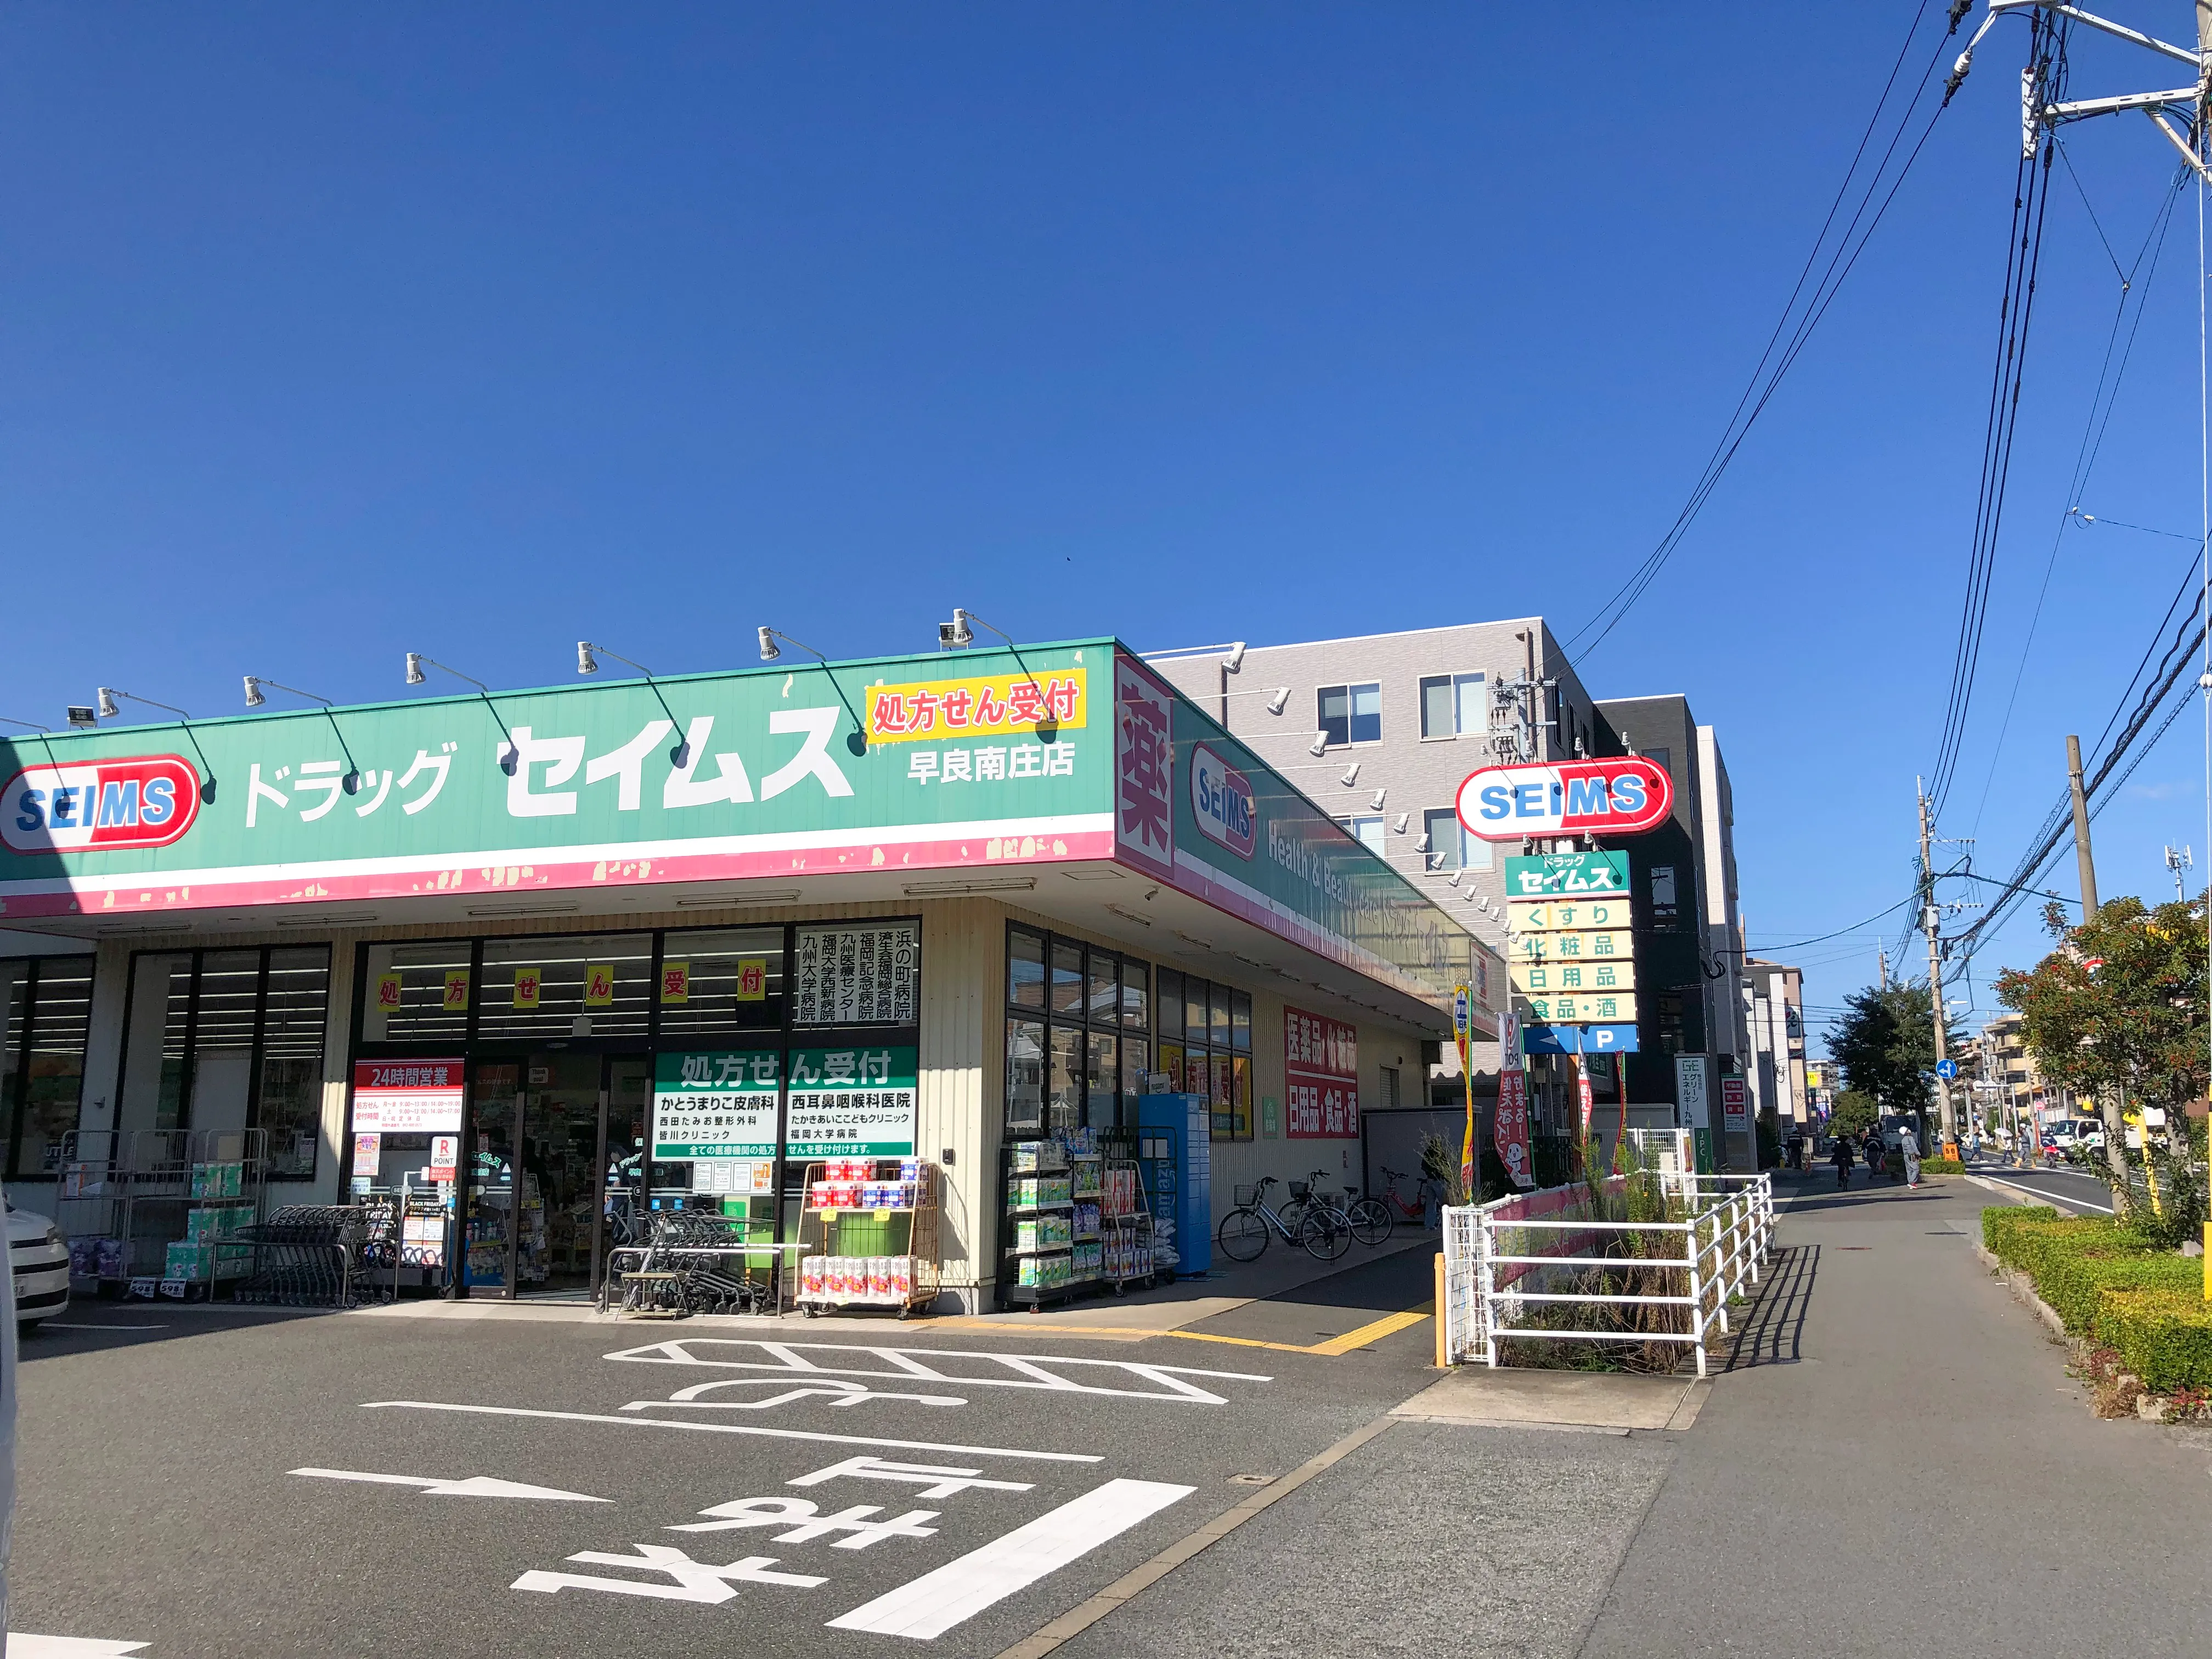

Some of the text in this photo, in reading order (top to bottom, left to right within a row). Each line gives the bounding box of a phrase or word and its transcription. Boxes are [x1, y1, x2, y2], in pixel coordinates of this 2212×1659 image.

[872, 677, 1080, 734] 処方せん受付
[246, 740, 459, 828] ドラッグ
[496, 706, 855, 817] セイムス
[907, 740, 1076, 786] 早良南庄店
[1120, 681, 1169, 854] 薬
[16, 776, 177, 832] SEIMS
[1198, 766, 1250, 838] SEIMS
[1479, 775, 1647, 820] SEIMS
[1268, 819, 1378, 924] Health & Beauty care
[1518, 866, 1614, 893] セイムス
[1543, 854, 1585, 869] ドラッグ
[1528, 906, 1609, 927] くすり
[1527, 935, 1615, 957] 化粧品
[800, 935, 818, 1021] 九州大学病院
[820, 934, 837, 1021] 福岡大学西新病院
[839, 933, 856, 1020] 九州医療センター
[858, 932, 875, 1020] 福岡記念病院
[876, 931, 894, 1019] 済生会福岡総合病院
[894, 930, 912, 1019] 浜の町病院
[1529, 967, 1617, 988] 日用品
[1530, 998, 1617, 1019] 食品・酒
[1287, 1012, 1357, 1072] 医薬品・化粧品
[1597, 1031, 1614, 1048] P
[371, 1066, 449, 1087] 24時間営業
[680, 1049, 892, 1089] 処方せん受付
[1690, 1074, 1699, 1103] グリーン
[356, 1101, 379, 1109] 処方せん
[356, 1112, 379, 1120] 受付時間
[659, 1115, 757, 1126] 西田たみお整形外科
[660, 1095, 775, 1111] かとうまりこ皮膚科
[791, 1092, 911, 1110] 西耳鼻咽喉科医院
[791, 1113, 909, 1125] たかきあいここどもクリニック
[1289, 1085, 1357, 1133] 日用品・食品・酒
[1682, 1074, 1692, 1126] エネルギー九州
[659, 1130, 730, 1141] 皆川クリニック
[790, 1128, 857, 1139] 福岡大学病院
[511, 1455, 1037, 1605] 止まれ
